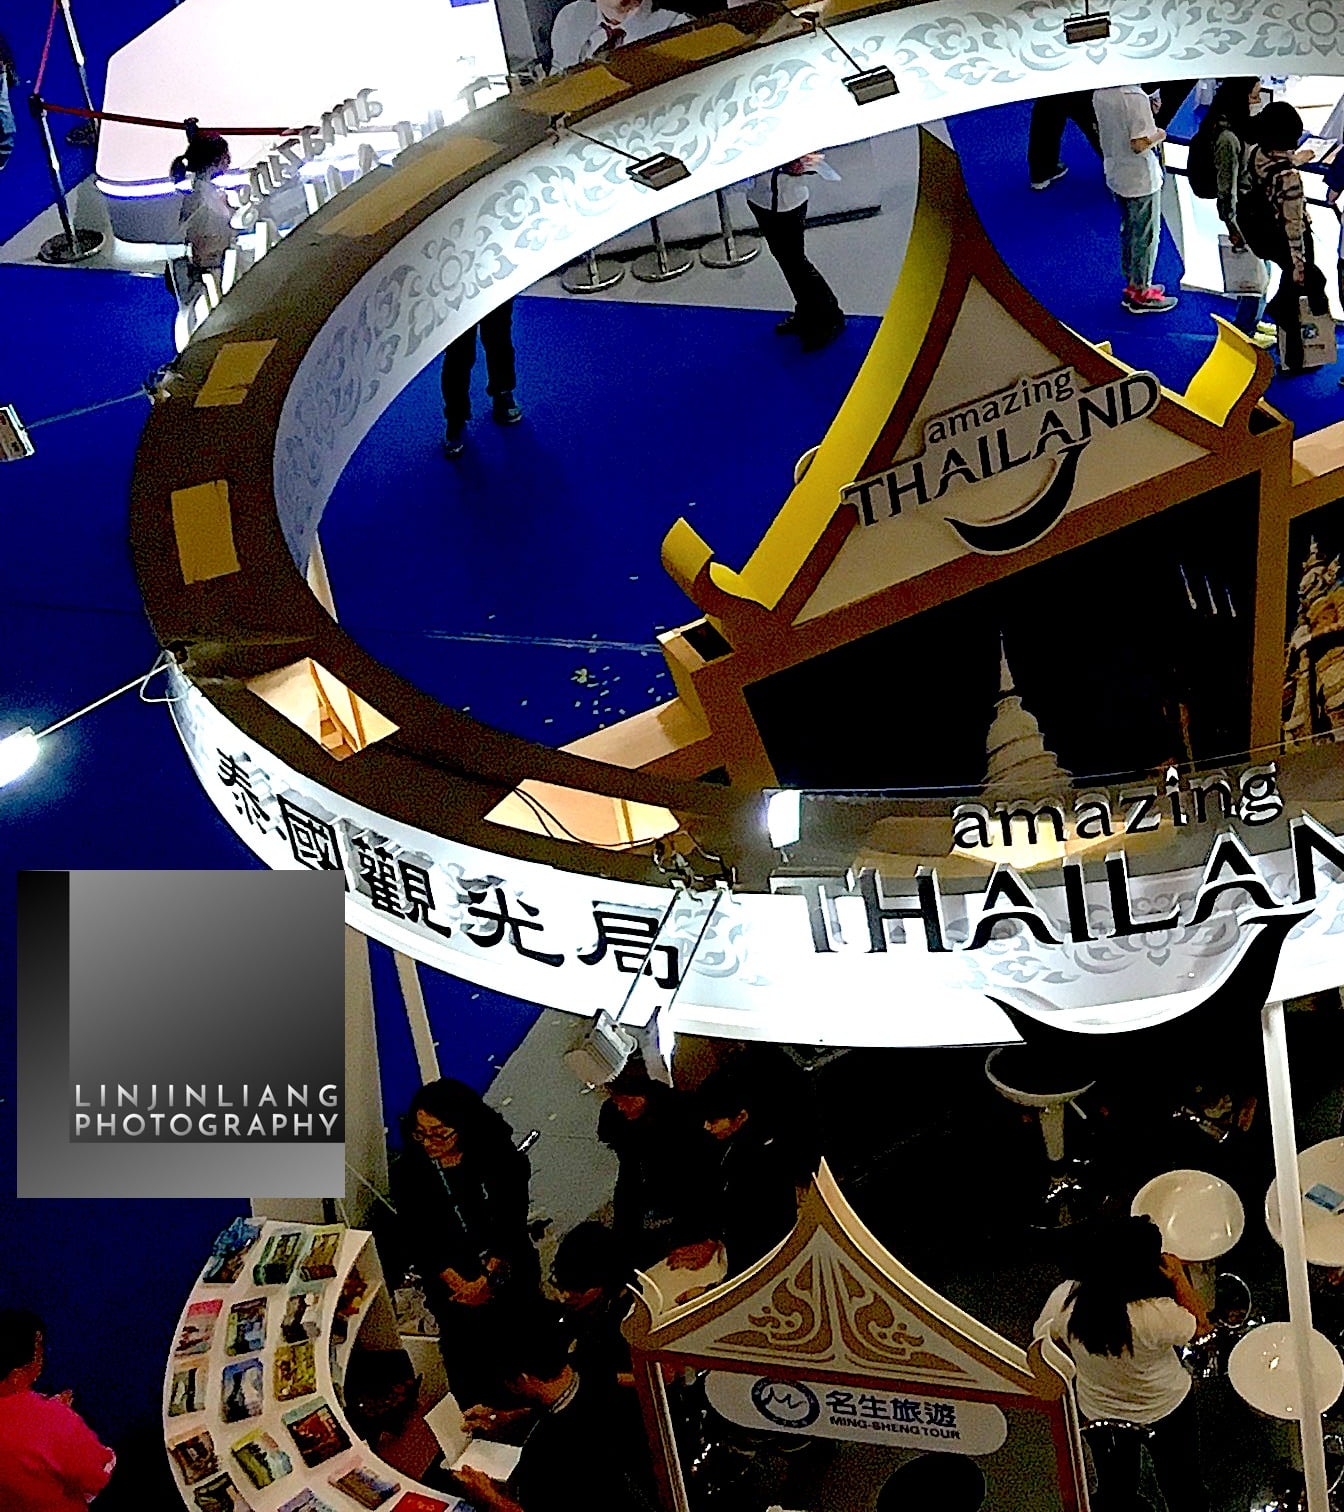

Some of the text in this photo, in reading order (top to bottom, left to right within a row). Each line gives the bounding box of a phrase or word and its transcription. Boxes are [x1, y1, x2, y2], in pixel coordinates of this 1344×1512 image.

[846, 372, 1161, 527] THAILAND
[926, 368, 1076, 445] amazing
[951, 760, 1283, 851] amazing
[218, 746, 681, 991] 泰國觀光局
[825, 1389, 958, 1426] 名生旅遊
